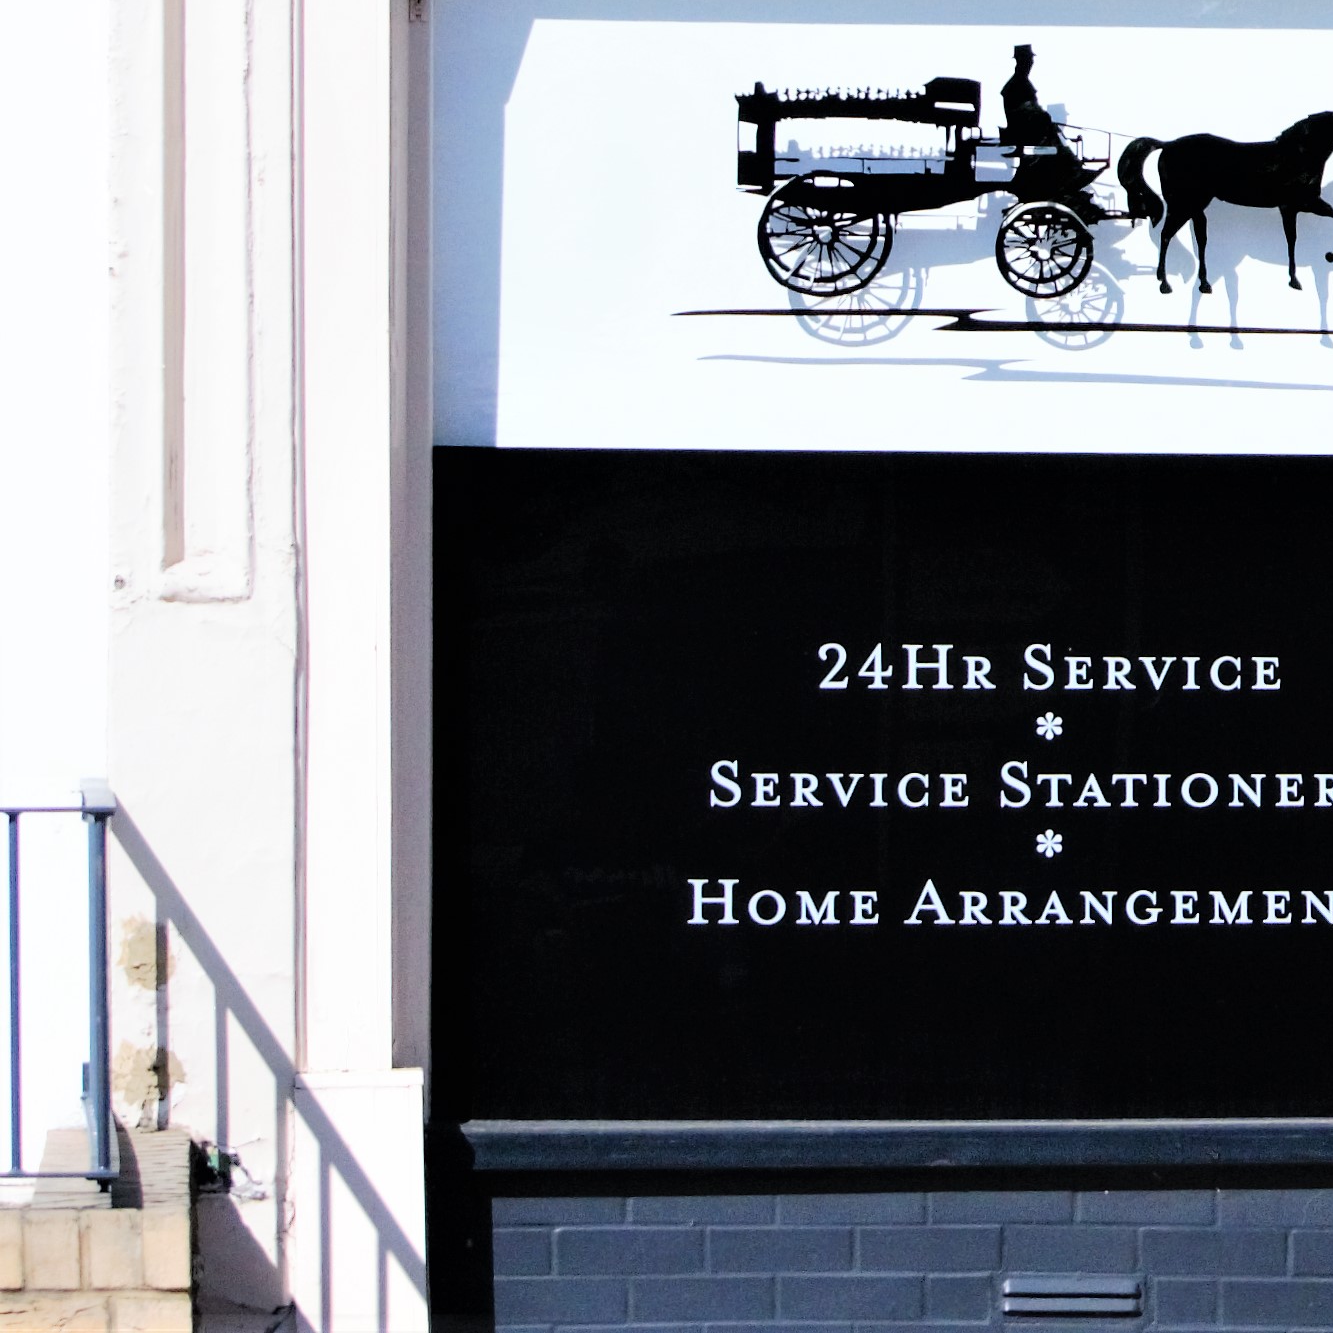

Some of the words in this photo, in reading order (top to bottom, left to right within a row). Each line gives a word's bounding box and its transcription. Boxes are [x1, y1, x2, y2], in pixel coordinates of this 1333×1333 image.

[1022, 643, 1282, 691] SERVICE
[709, 760, 970, 808] SERVICE
[687, 878, 881, 926] HOME
